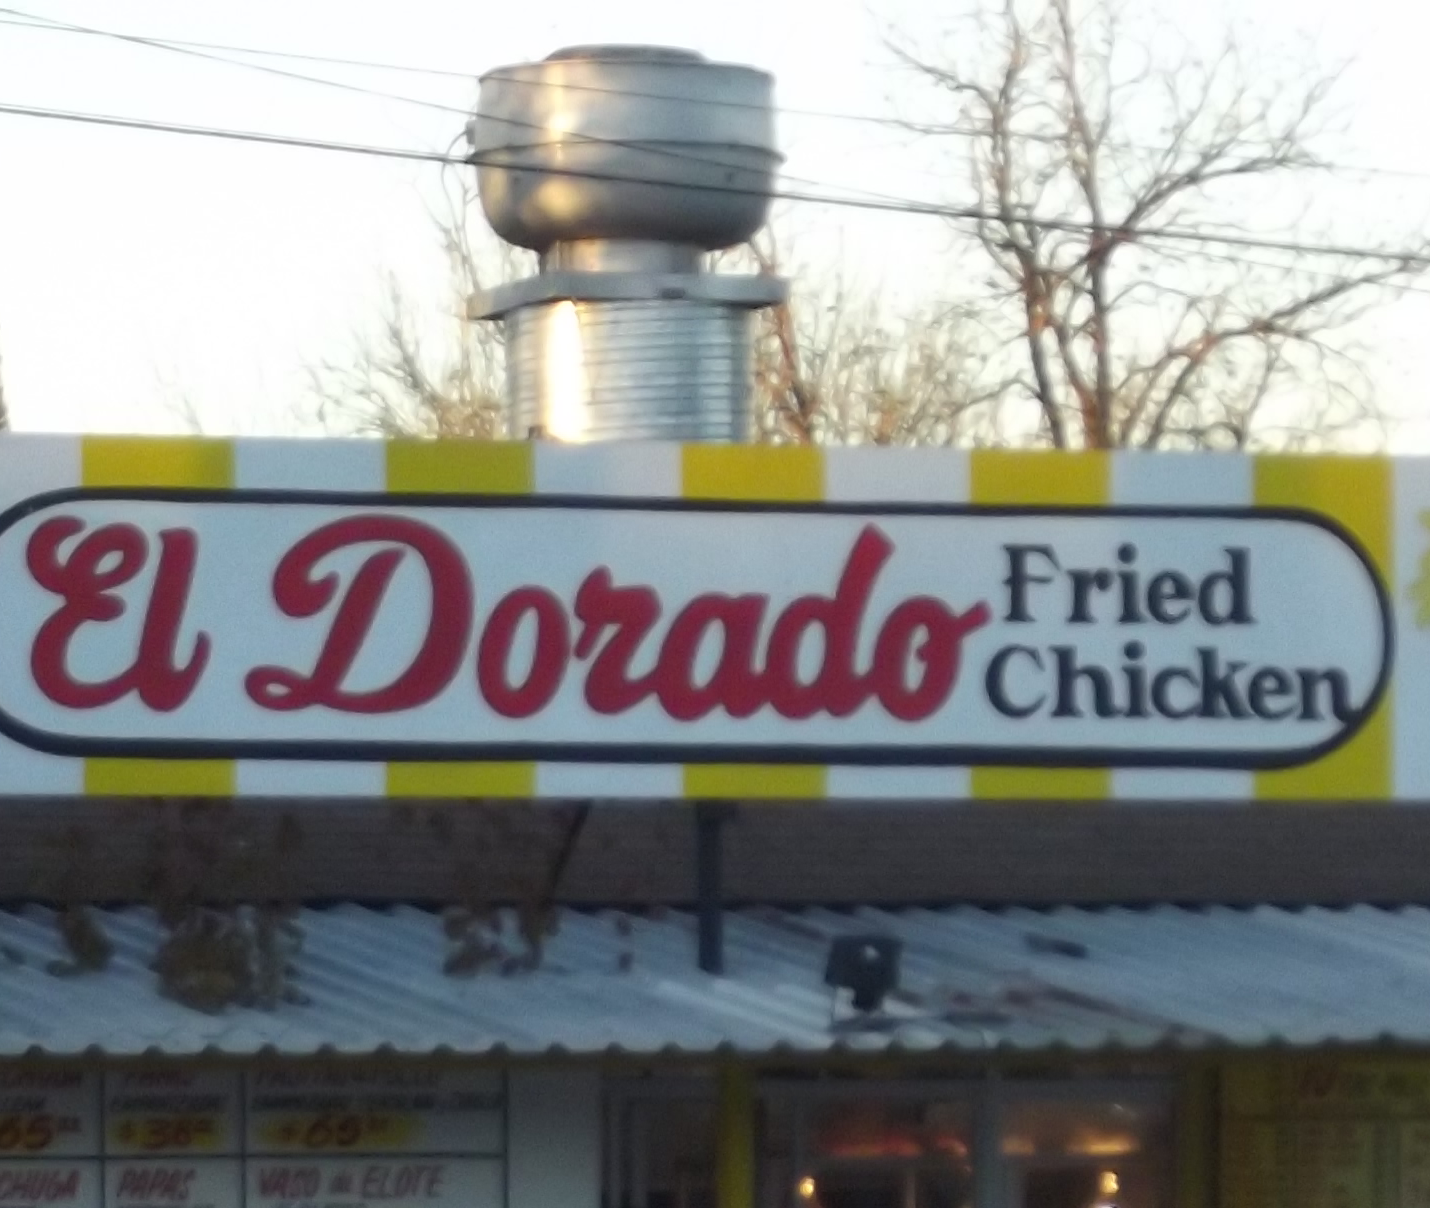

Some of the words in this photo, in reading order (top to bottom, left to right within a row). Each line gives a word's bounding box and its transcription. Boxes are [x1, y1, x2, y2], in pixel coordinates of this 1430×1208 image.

[26, 515, 210, 712] El
[245, 515, 990, 720] Dorado
[1000, 544, 1257, 627] Fried
[984, 645, 1361, 723] Chicken
[117, 1167, 196, 1202] PAPAS
[258, 1166, 321, 1199] VASO
[360, 1165, 446, 1198] ELOTE
